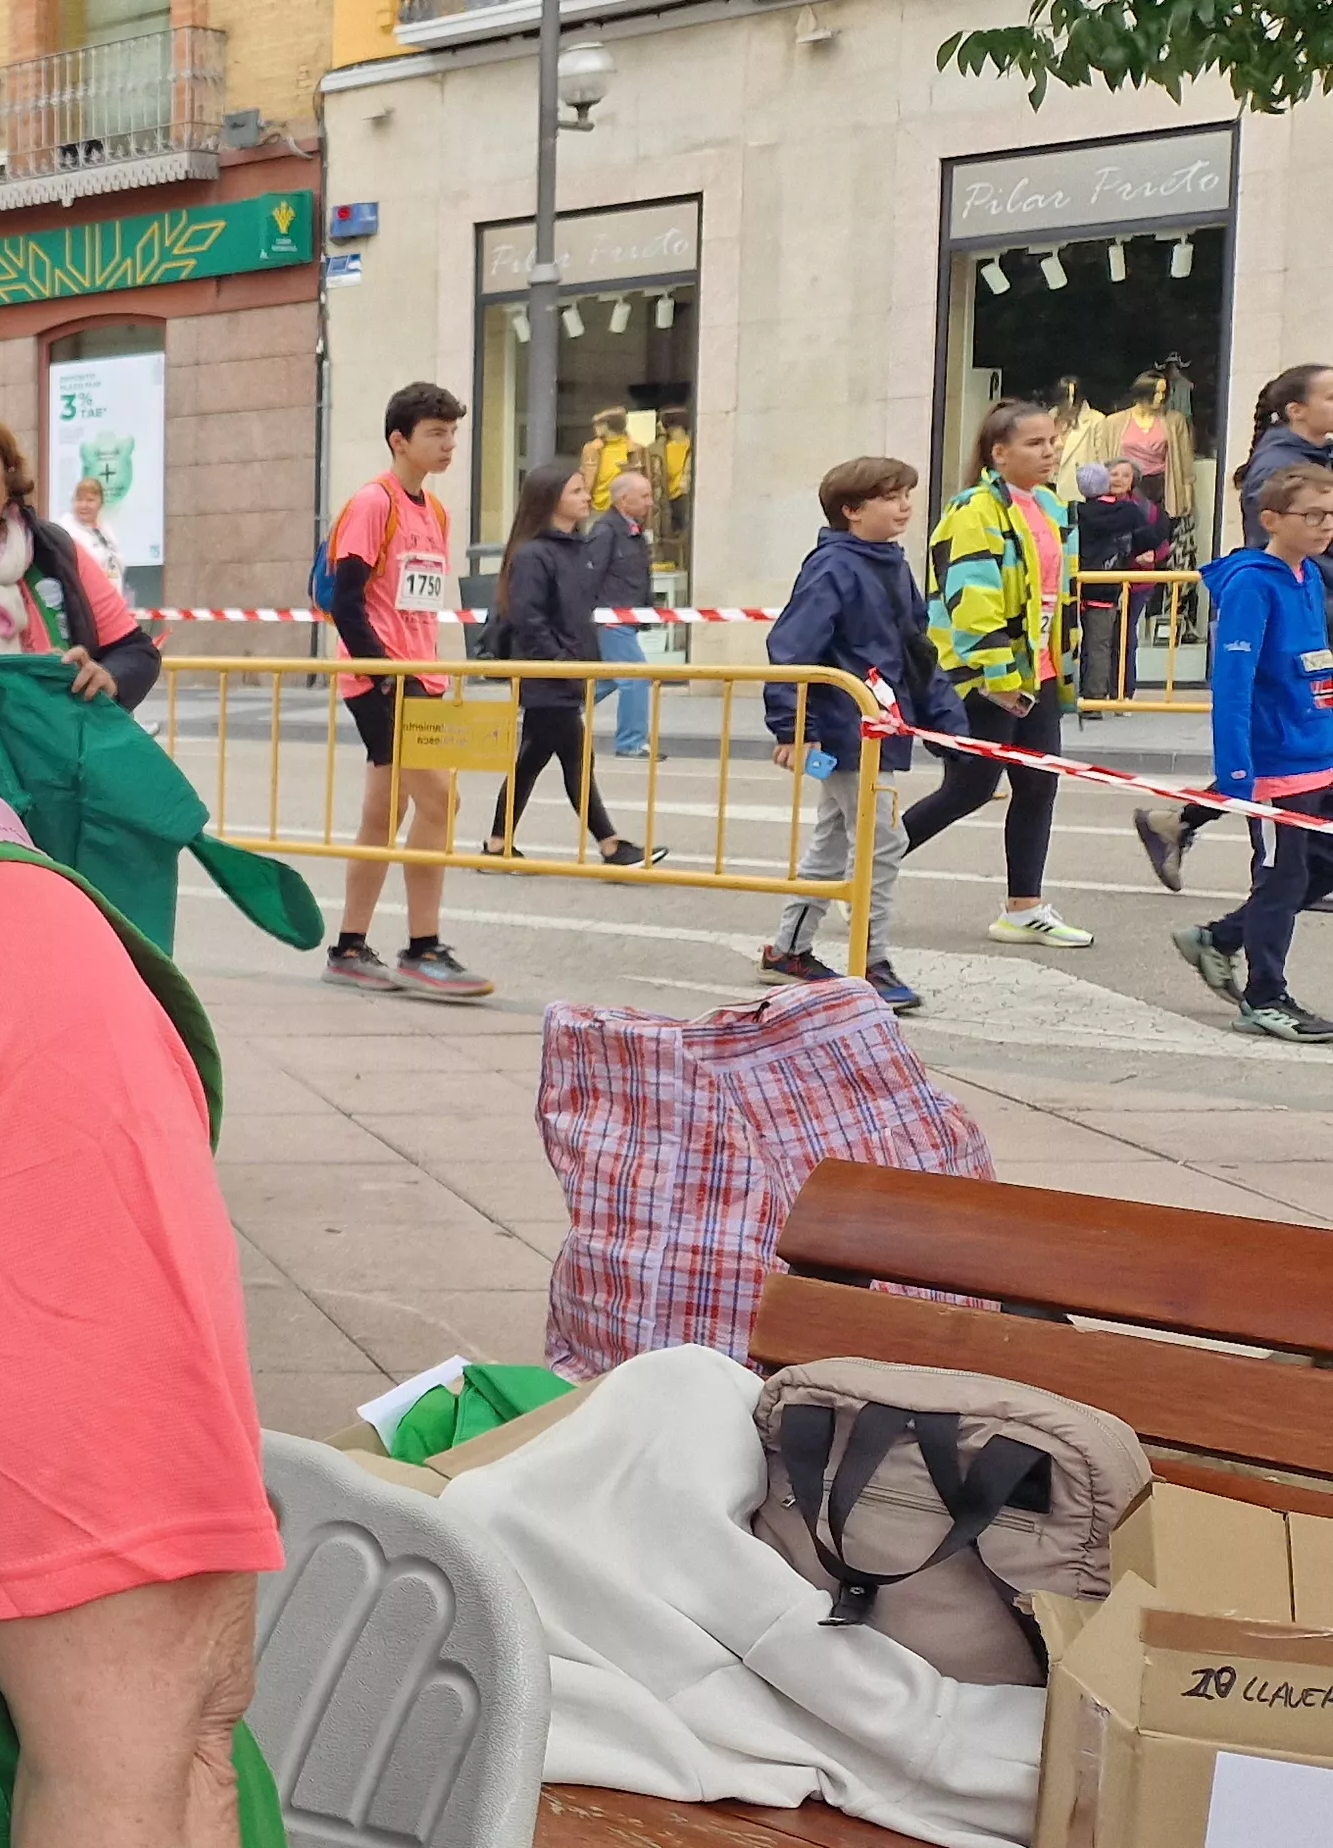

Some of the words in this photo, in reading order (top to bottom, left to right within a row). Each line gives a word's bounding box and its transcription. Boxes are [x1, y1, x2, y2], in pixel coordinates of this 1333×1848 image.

[962, 176, 1072, 219] Pilar
[1090, 159, 1220, 204] Prieto
[60, 393, 77, 422] 3
[406, 573, 442, 597] 1750
